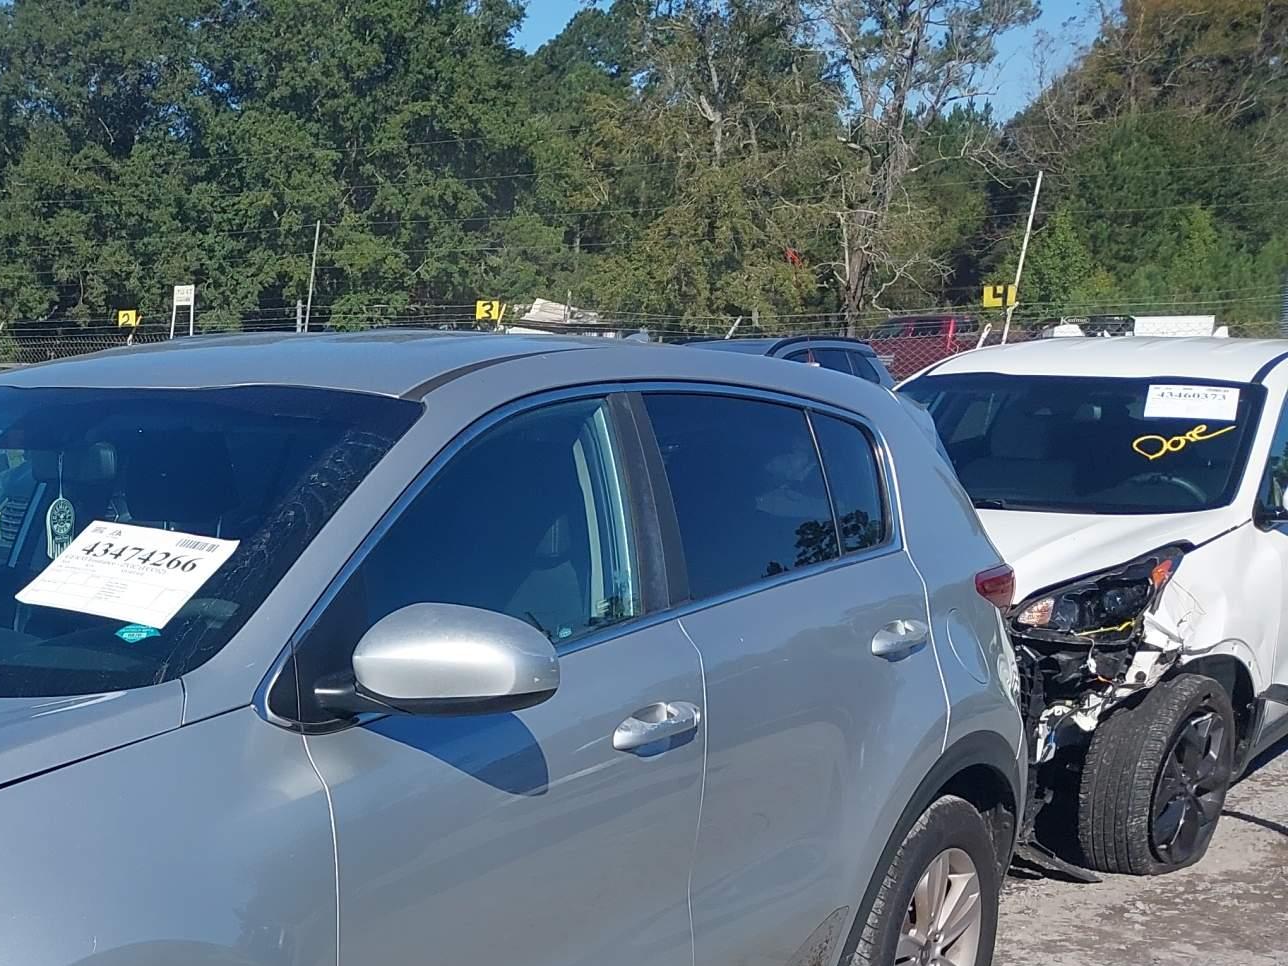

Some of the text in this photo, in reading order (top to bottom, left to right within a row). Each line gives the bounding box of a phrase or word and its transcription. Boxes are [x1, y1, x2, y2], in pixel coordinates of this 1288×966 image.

[481, 303, 494, 319] 3
[120, 313, 132, 326] 2
[82, 540, 204, 573] 43474266
